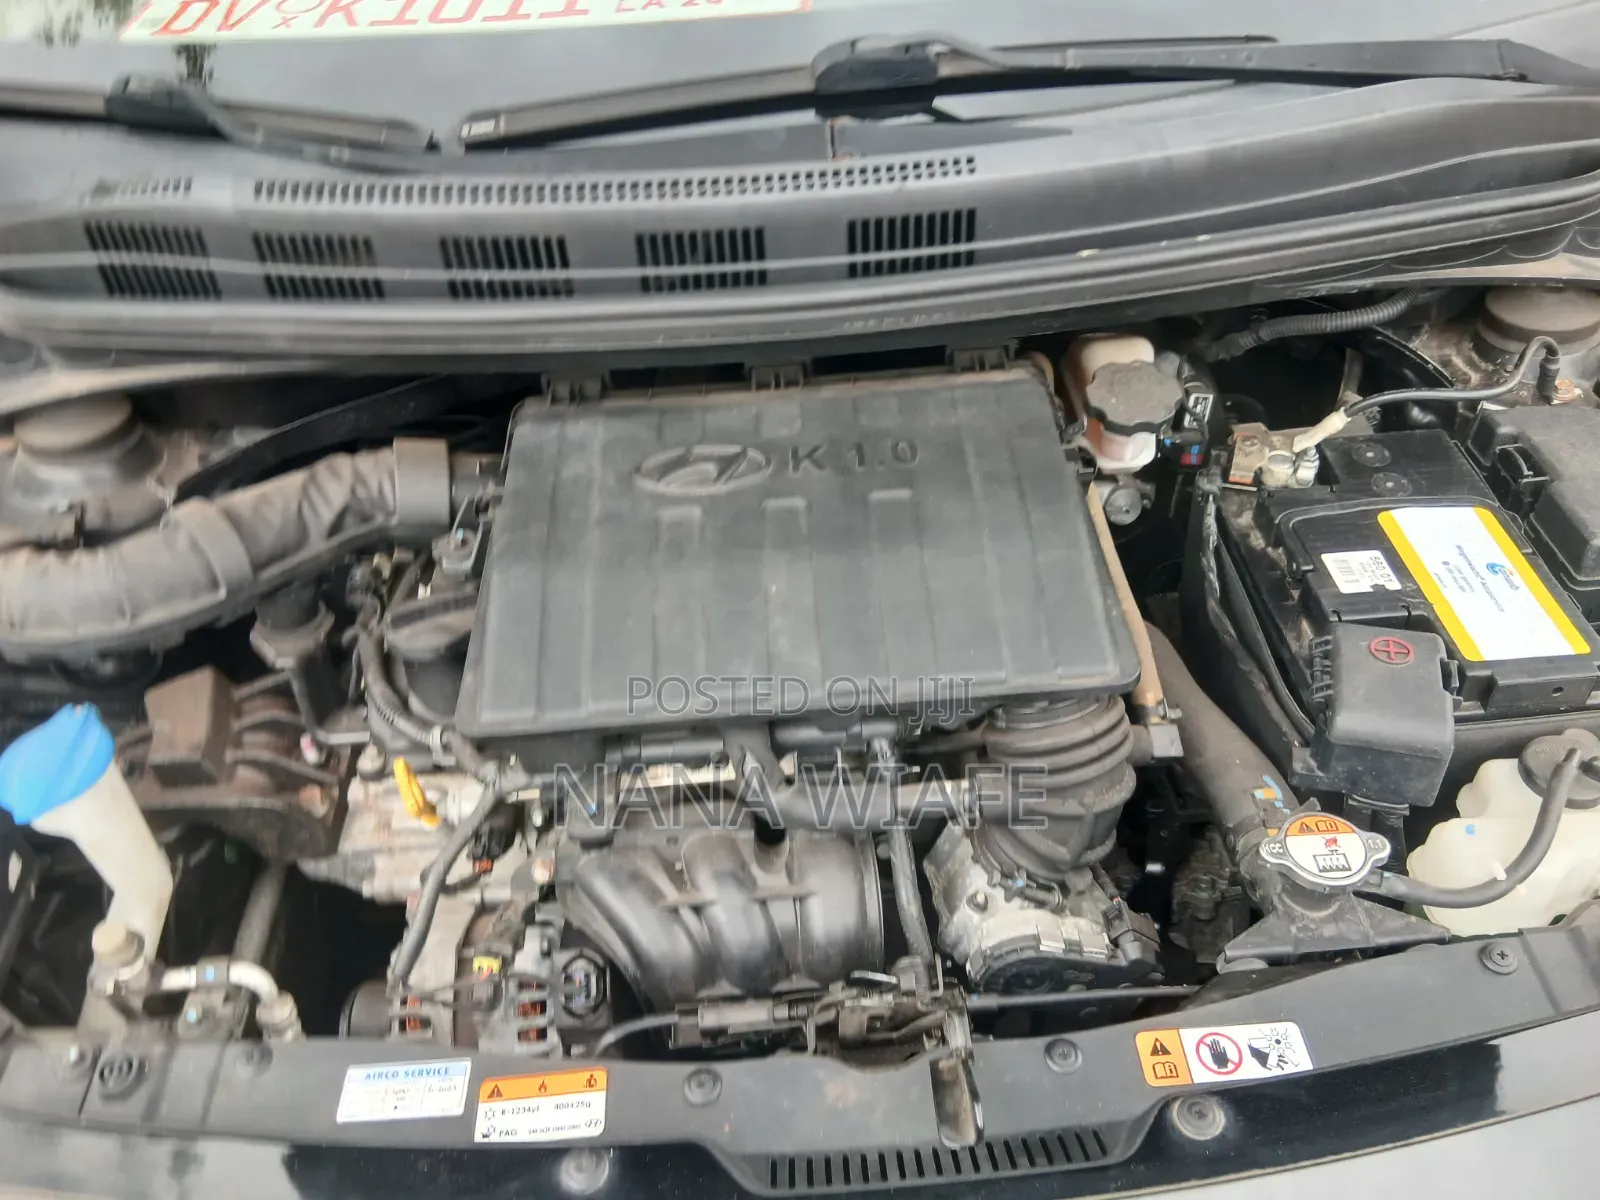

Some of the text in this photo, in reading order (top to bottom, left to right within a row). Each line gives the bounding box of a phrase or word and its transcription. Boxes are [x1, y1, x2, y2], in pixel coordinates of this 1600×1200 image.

[789, 437, 920, 476] K 1.0
[365, 1066, 450, 1081] AIRCO SERVICE
[499, 1128, 518, 1138] PAG
